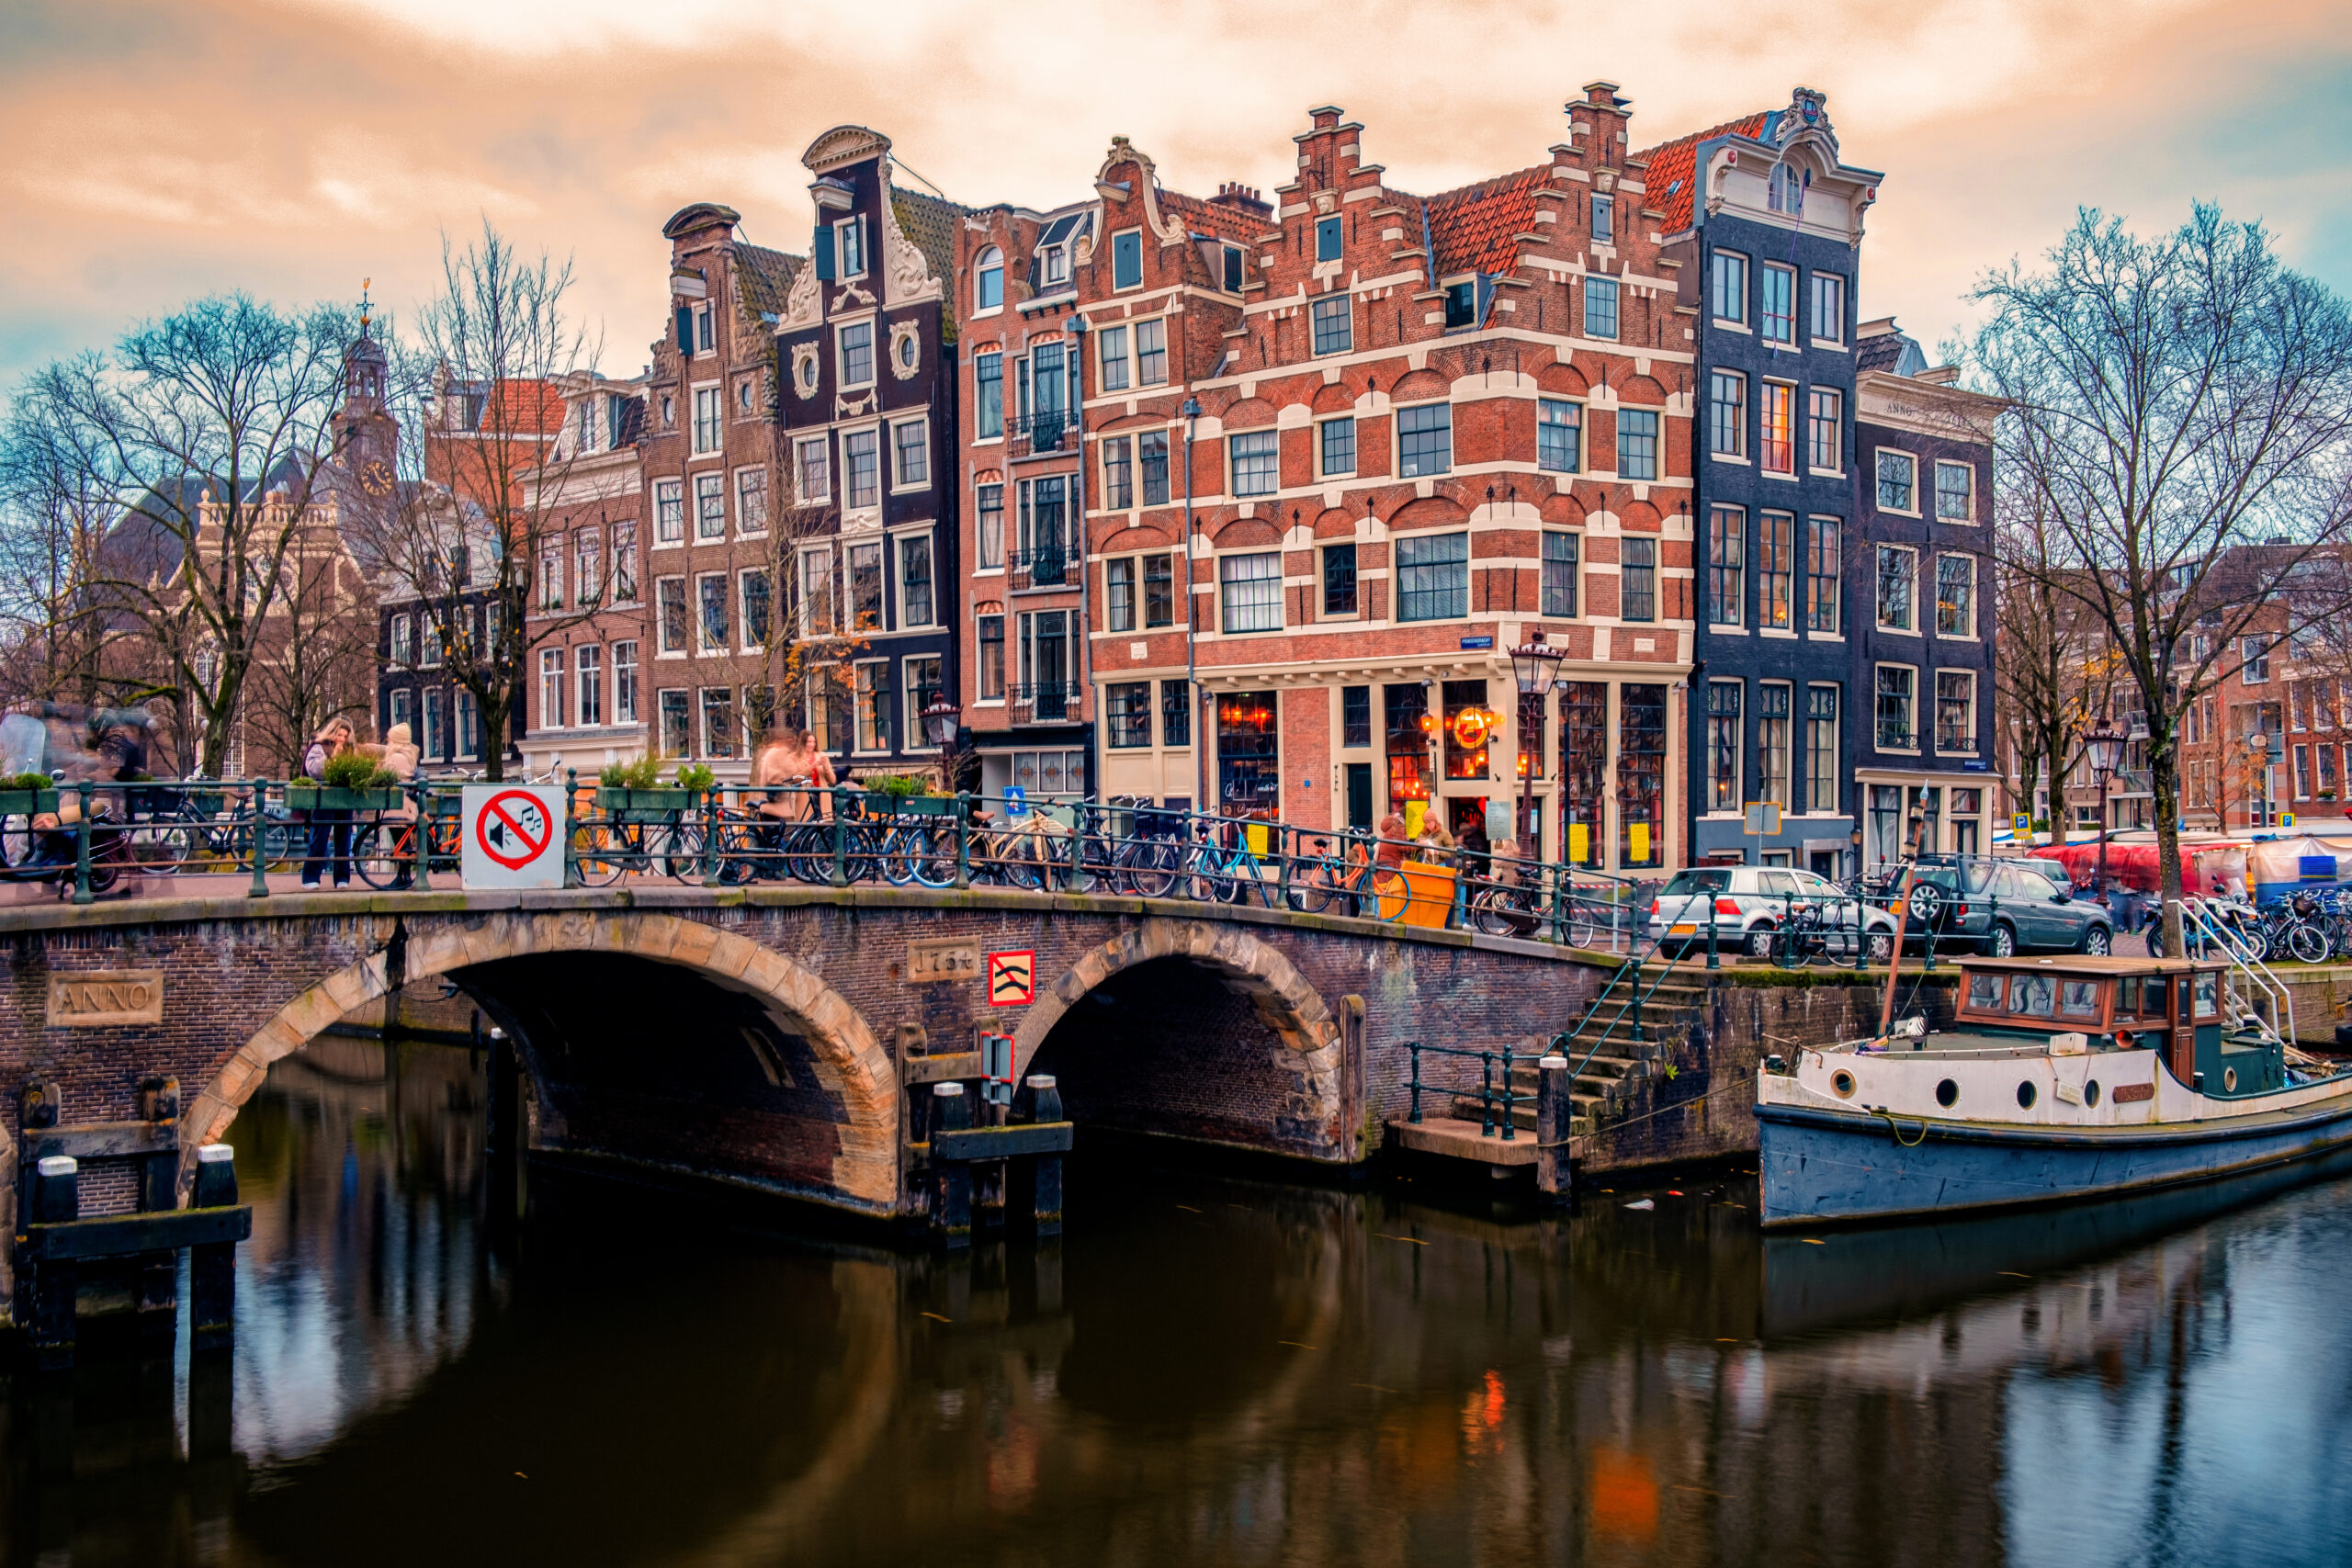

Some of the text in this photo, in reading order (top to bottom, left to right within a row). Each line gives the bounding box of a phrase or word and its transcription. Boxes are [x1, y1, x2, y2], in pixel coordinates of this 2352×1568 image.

[1886, 403, 1912, 416] ANNO
[2018, 816, 2026, 828] P
[2284, 817, 2291, 826] P
[57, 983, 149, 1011] ANNO
